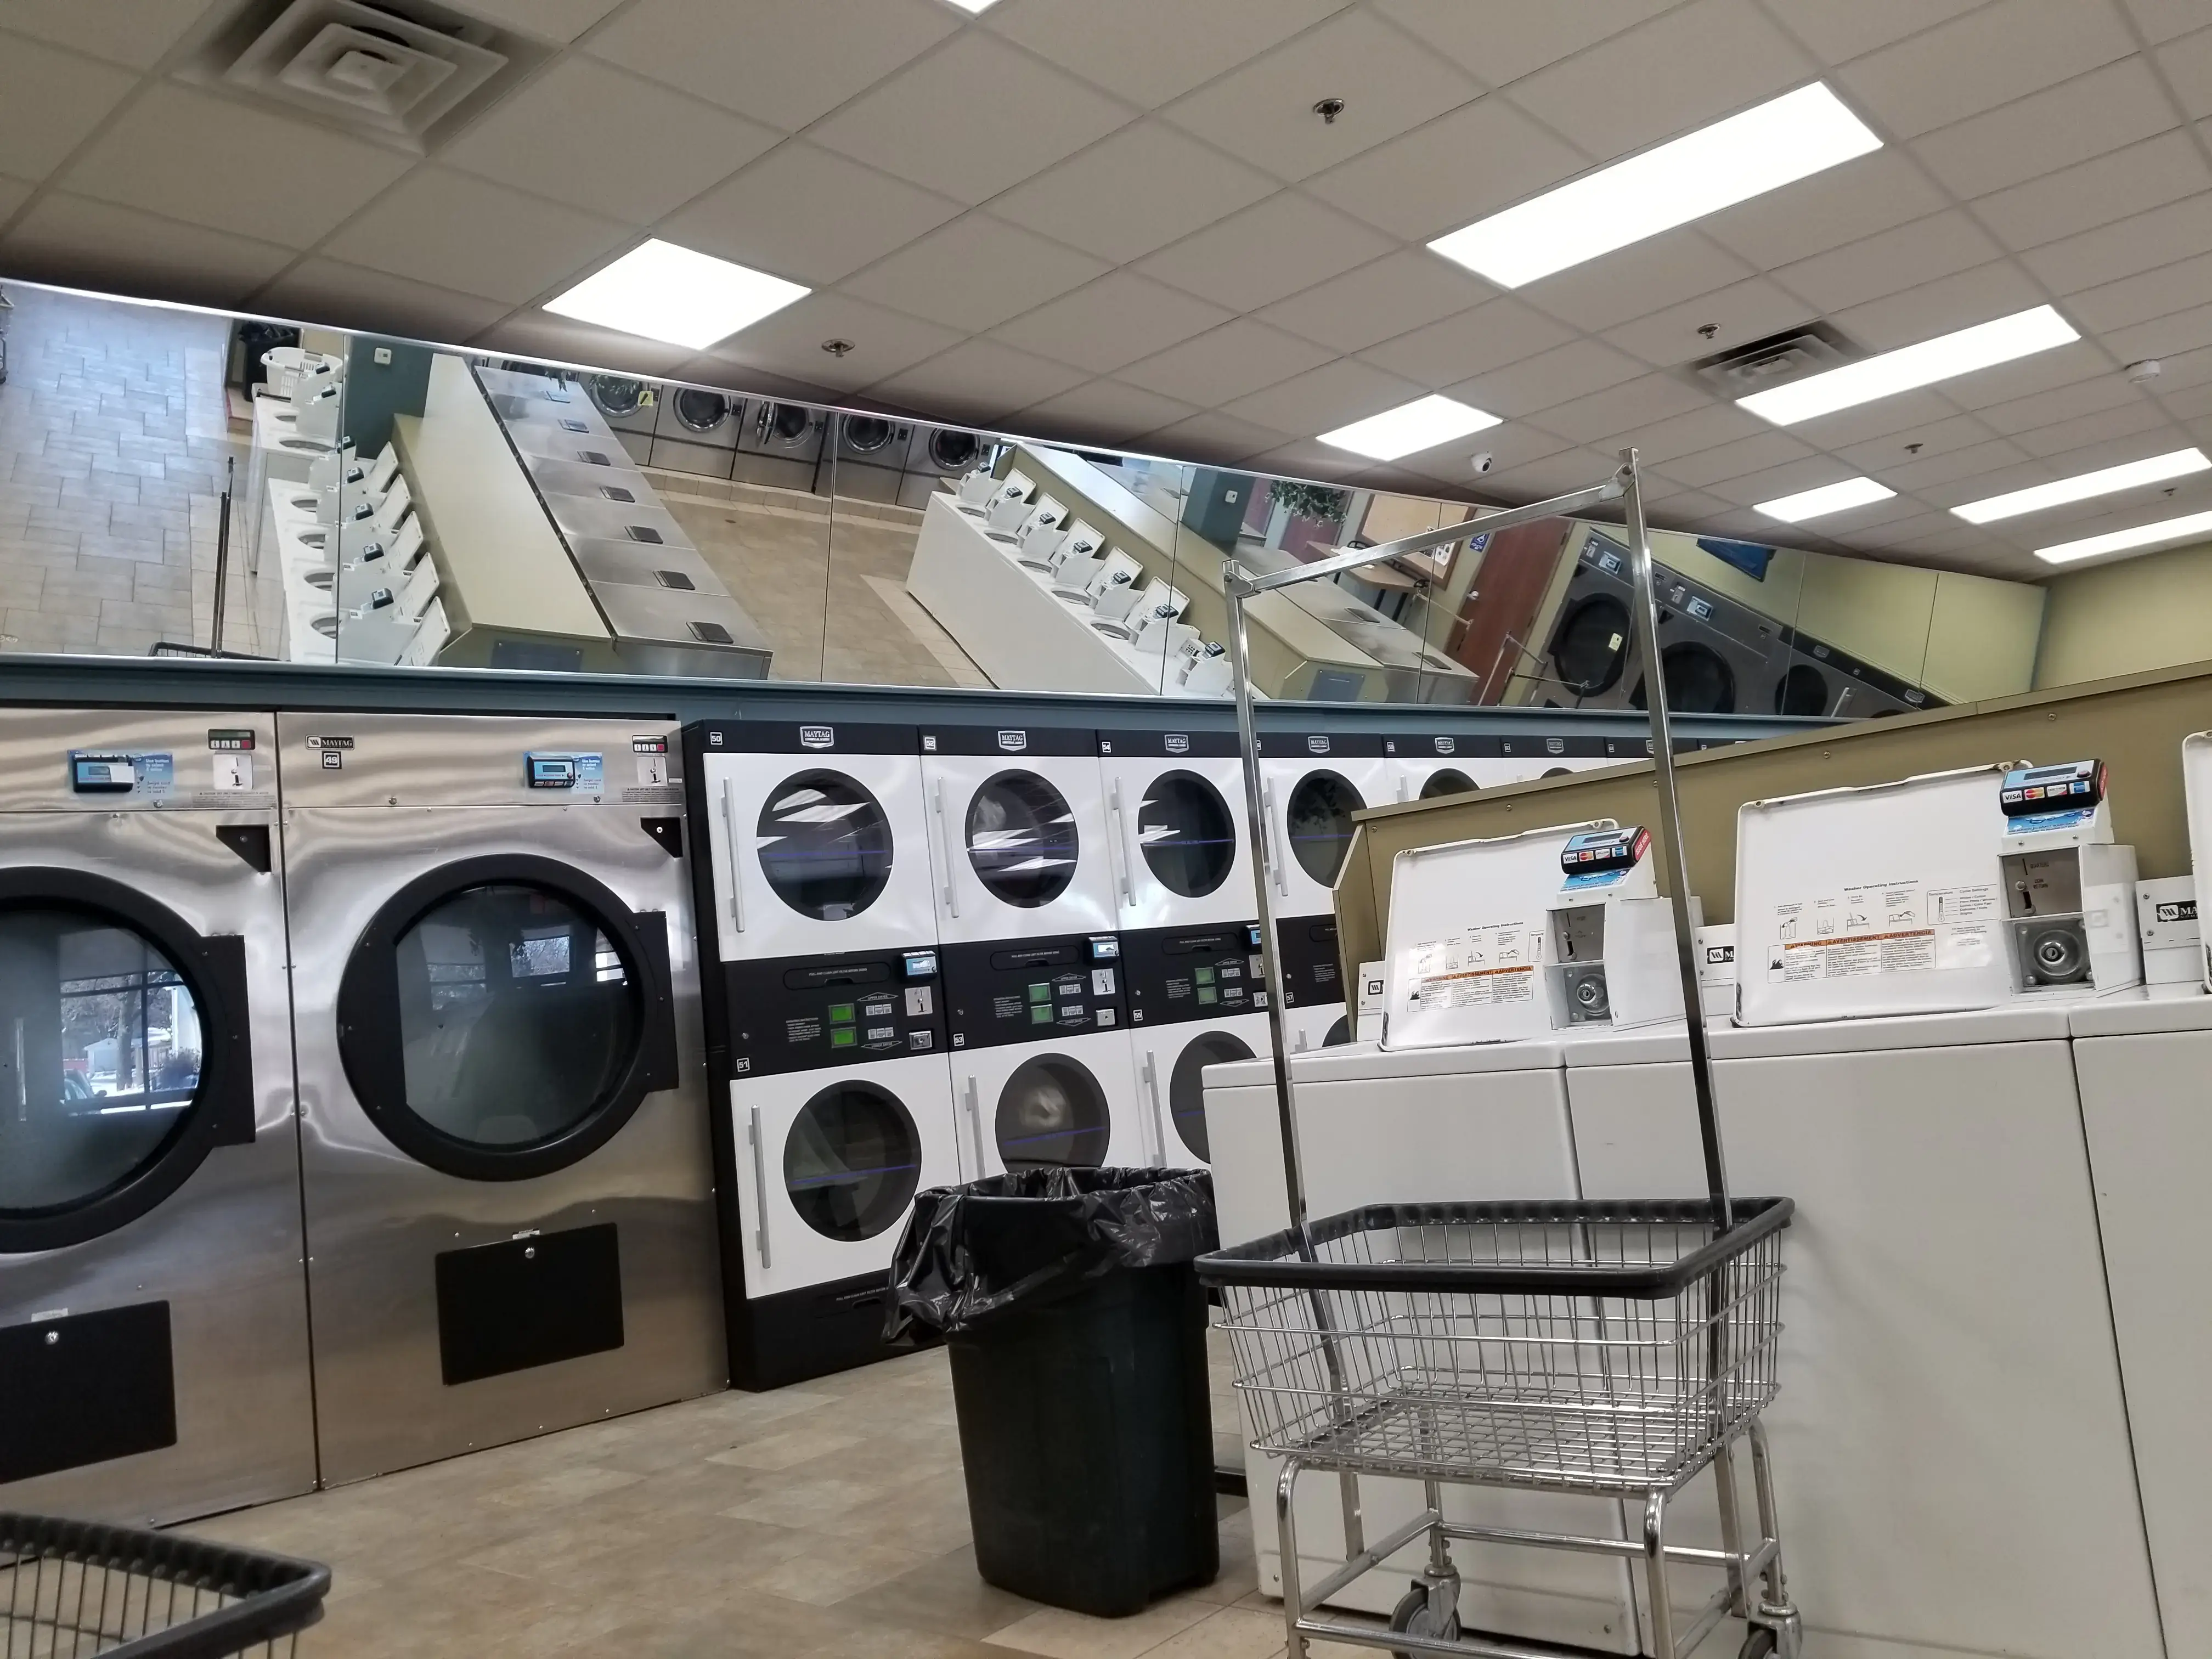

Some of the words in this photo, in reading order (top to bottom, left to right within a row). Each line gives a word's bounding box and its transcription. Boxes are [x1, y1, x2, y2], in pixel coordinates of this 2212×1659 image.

[325, 756, 337, 764] 49
[1832, 935, 1880, 944] AVERTISSEMENT
[1889, 929, 1932, 939] ADVERTENCIA
[955, 1036, 963, 1044] 53
[739, 1060, 748, 1069] 51
